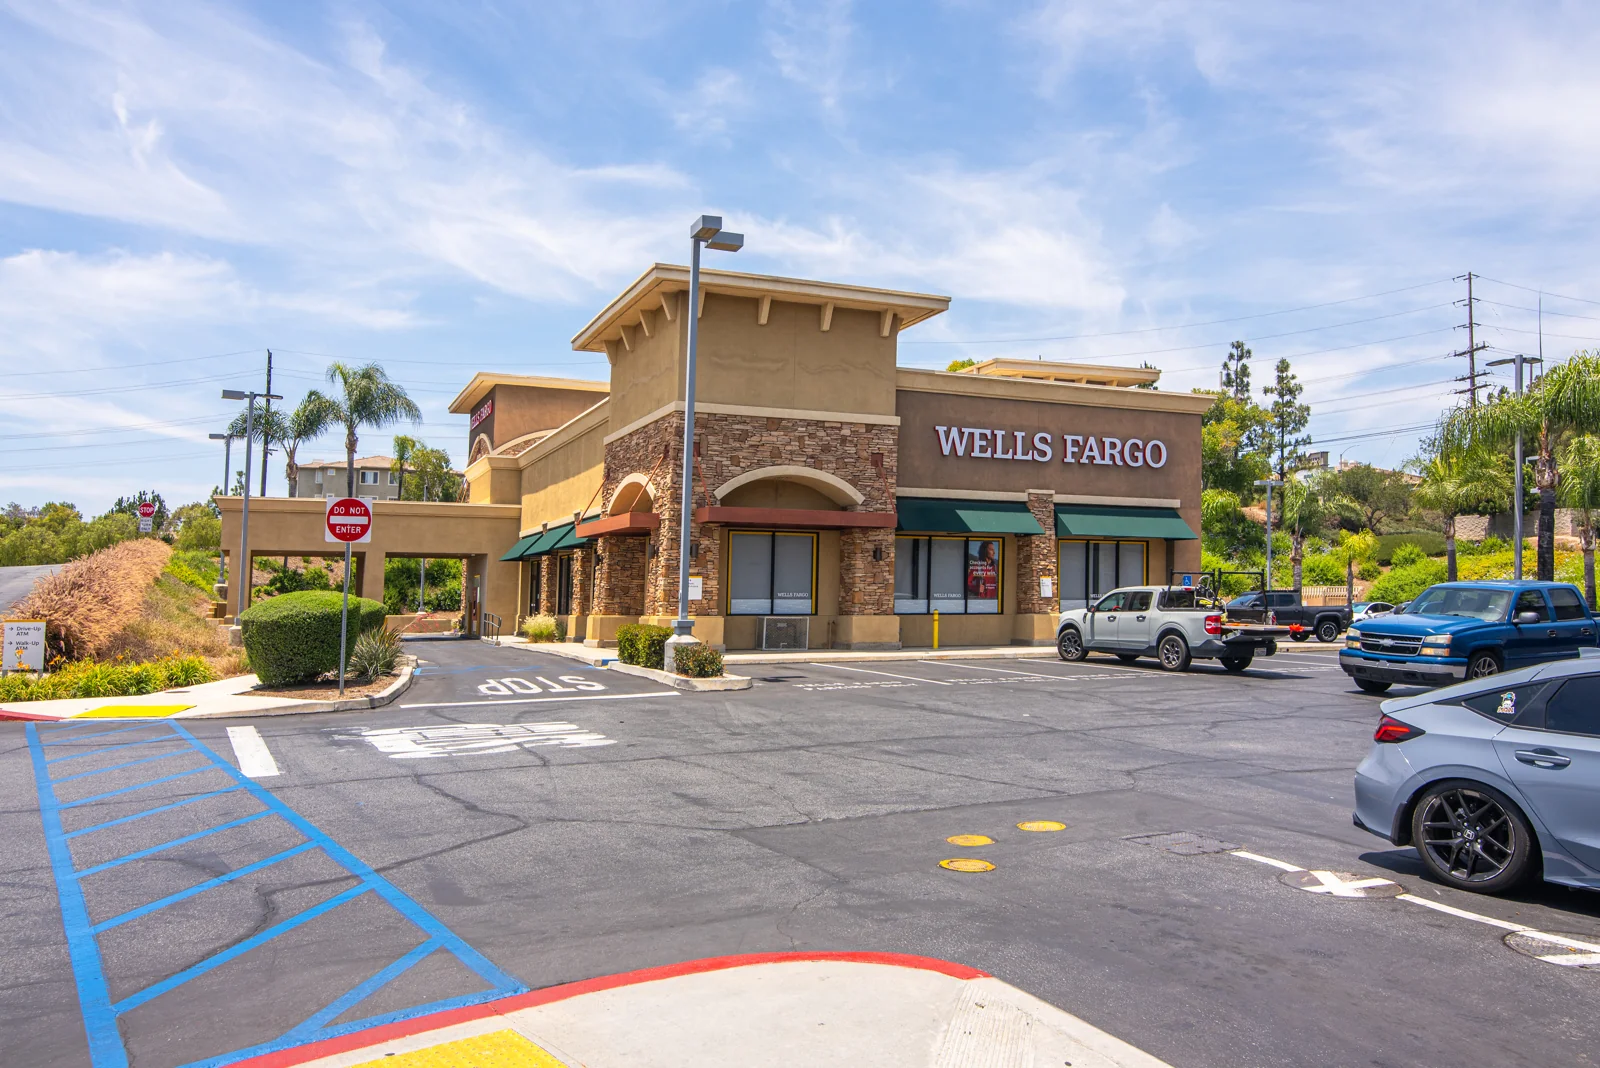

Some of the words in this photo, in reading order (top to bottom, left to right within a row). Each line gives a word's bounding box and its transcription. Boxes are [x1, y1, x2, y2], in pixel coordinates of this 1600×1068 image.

[934, 425, 1053, 462] WELLS
[1062, 434, 1168, 468] FARGO
[333, 506, 345, 514] DO
[477, 675, 609, 695] STOP
